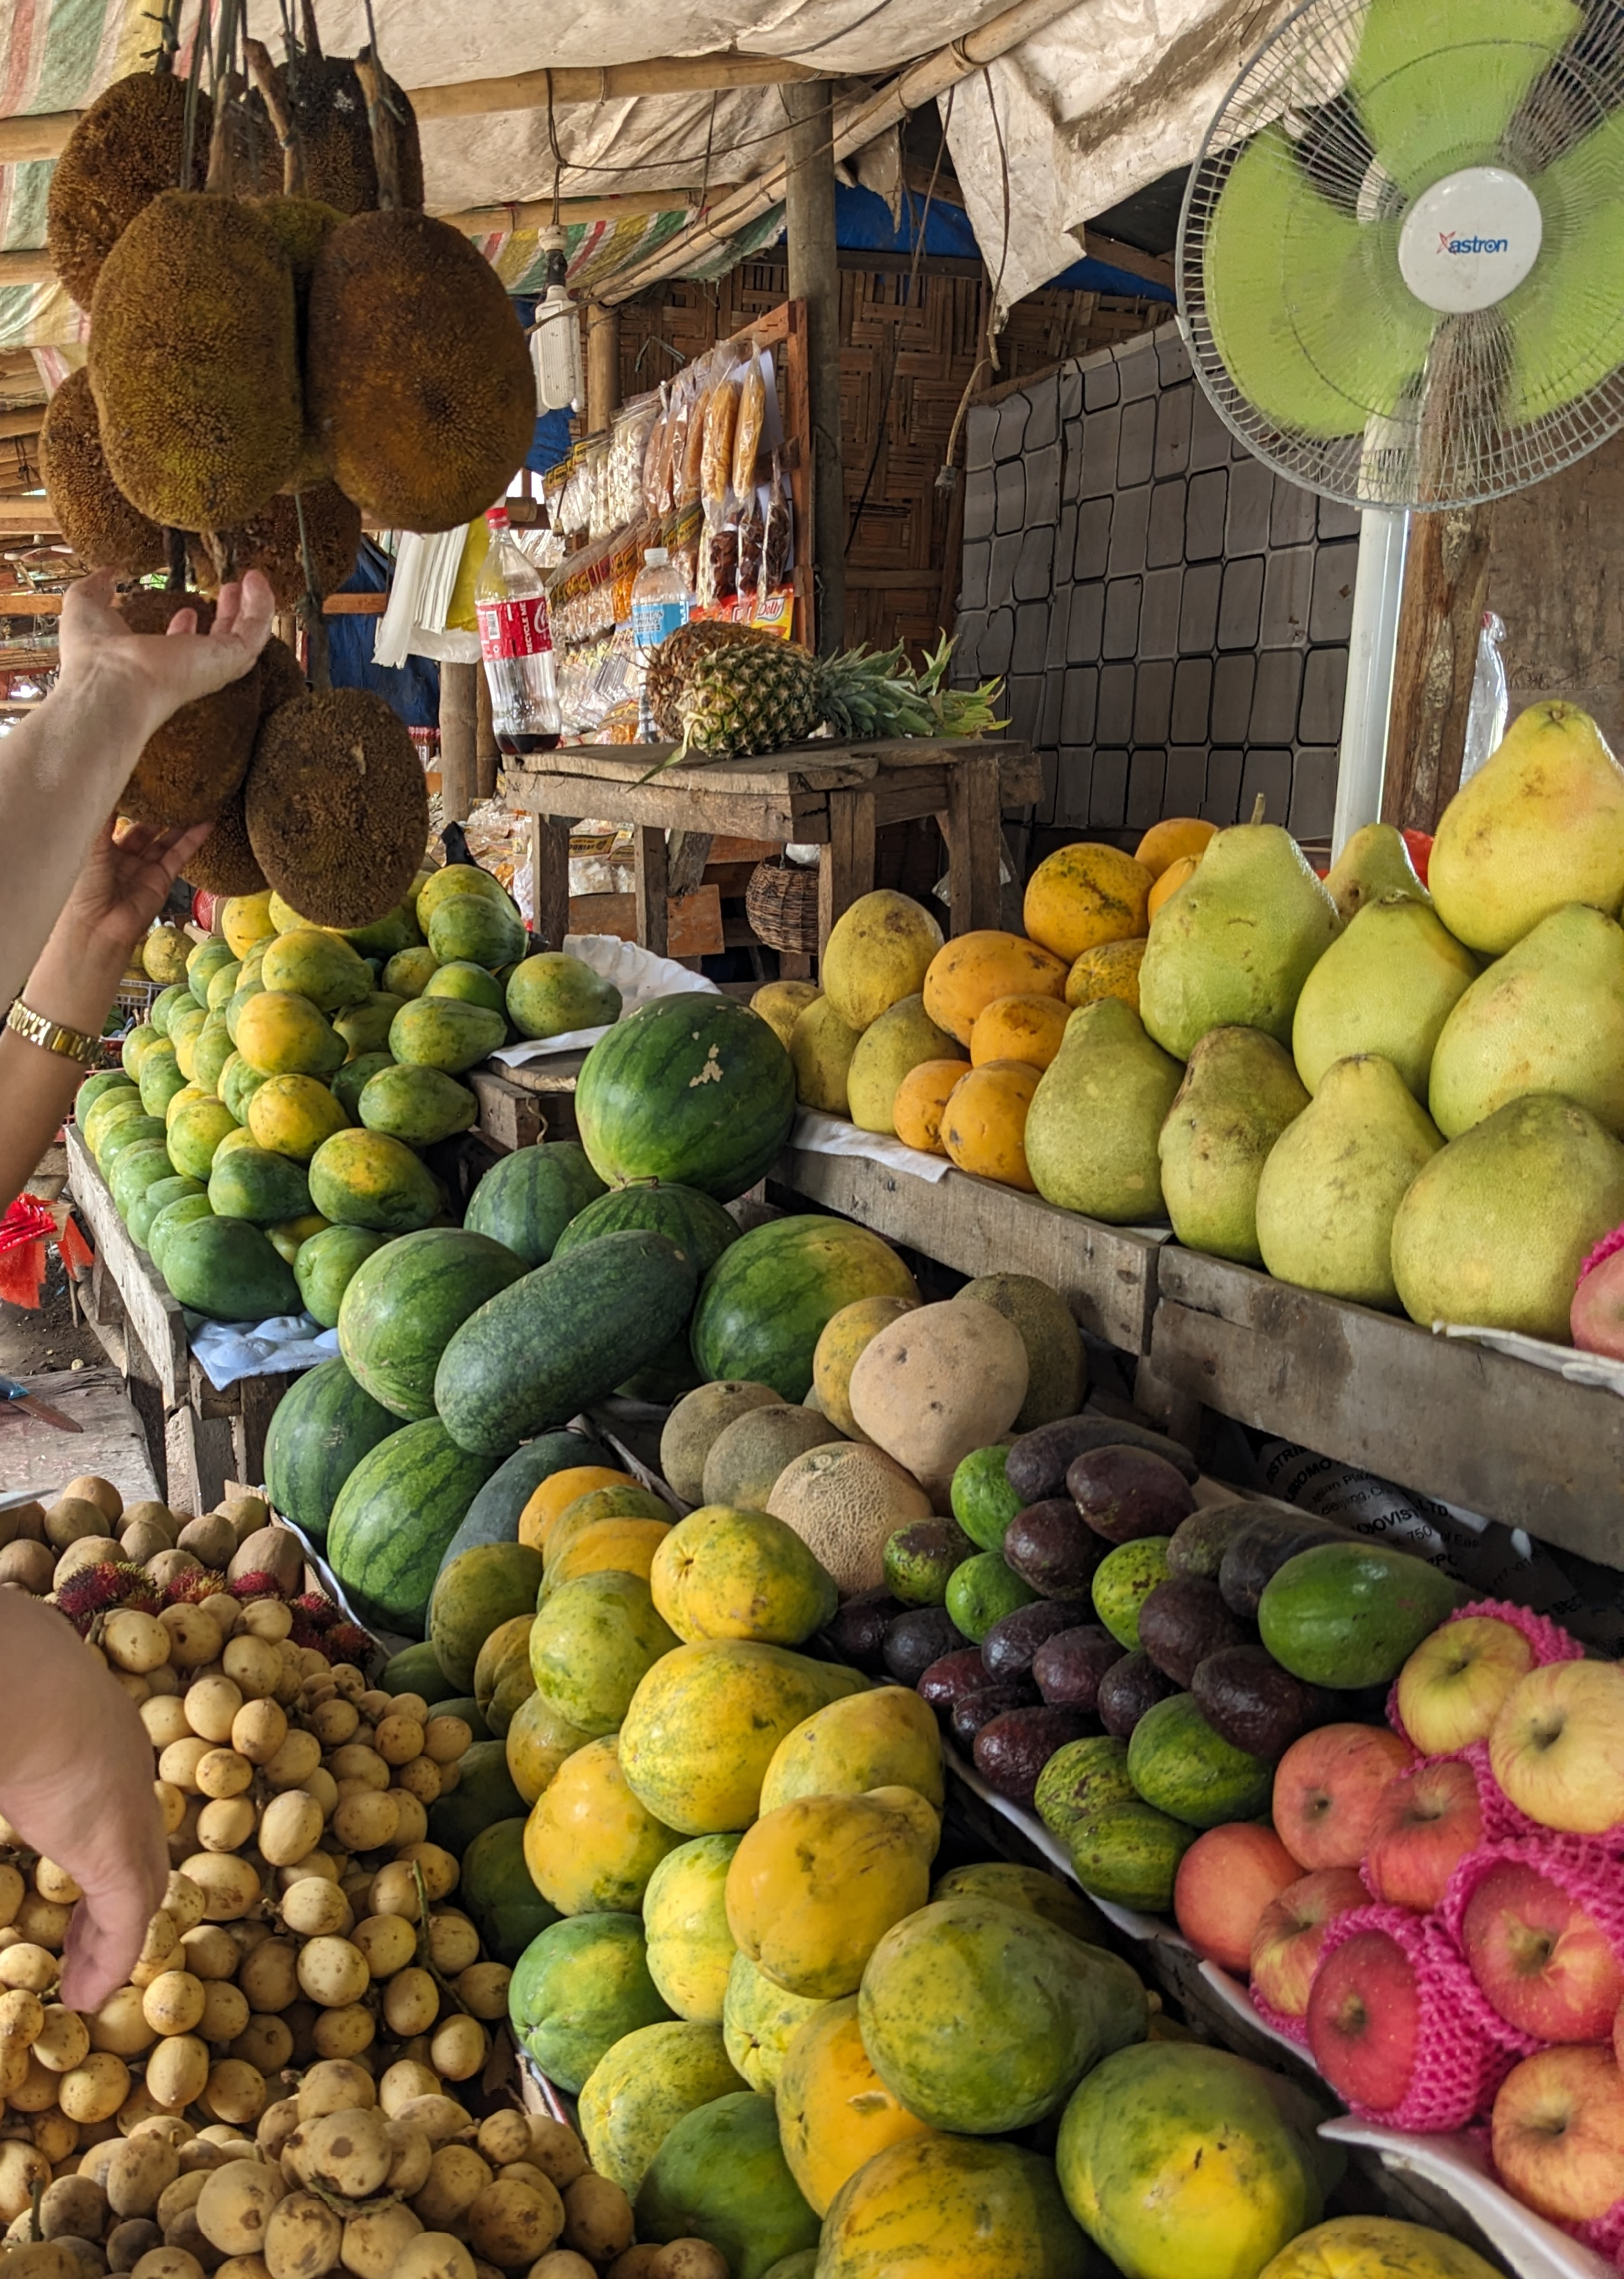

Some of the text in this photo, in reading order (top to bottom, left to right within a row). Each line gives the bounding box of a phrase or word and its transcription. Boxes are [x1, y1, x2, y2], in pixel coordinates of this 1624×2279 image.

[519, 601, 533, 654] RECYCLE ME
[1406, 1525, 1432, 1540] 750
